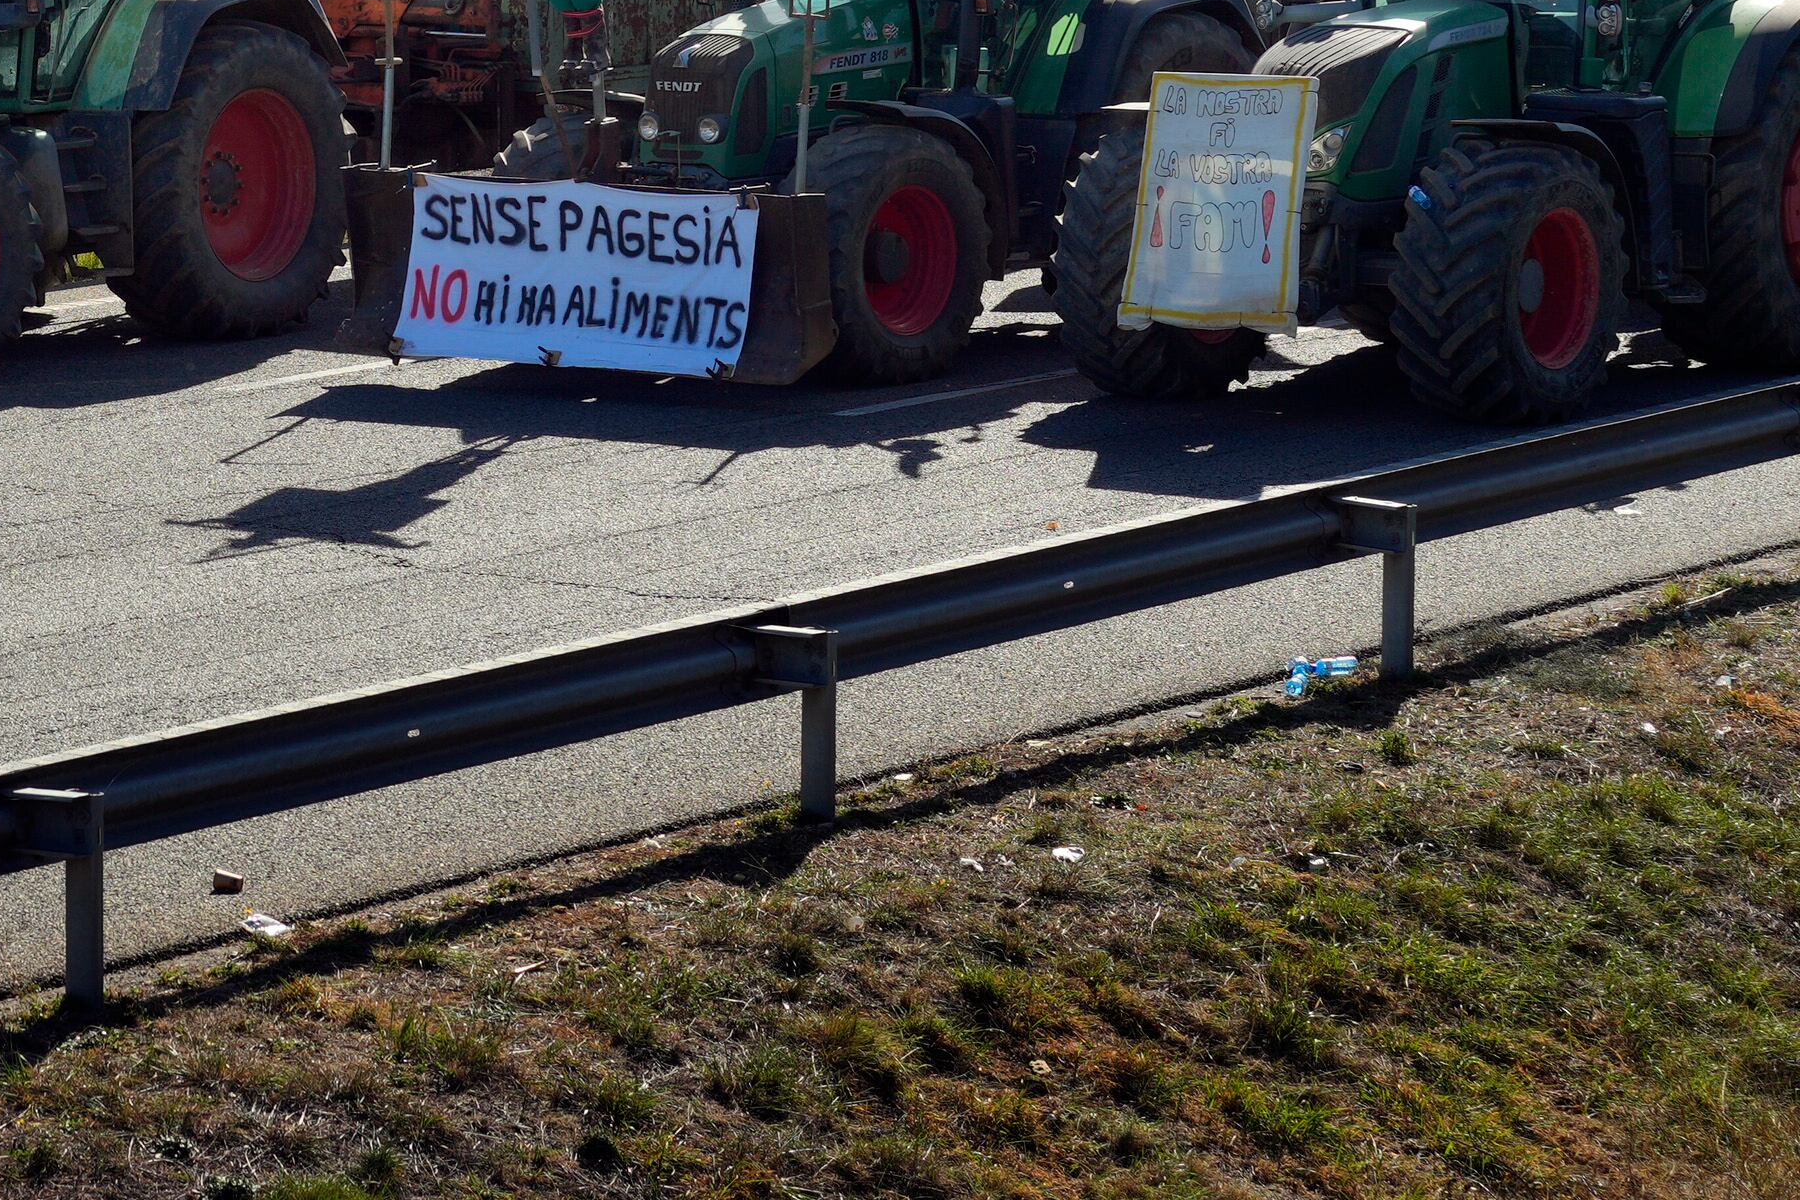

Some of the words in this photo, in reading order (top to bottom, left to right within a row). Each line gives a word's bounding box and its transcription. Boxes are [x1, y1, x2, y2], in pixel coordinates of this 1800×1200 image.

[829, 53, 867, 69] FENDT
[870, 50, 889, 63] 818
[656, 81, 702, 92] FENDT
[1163, 85, 1187, 116] LA
[1196, 88, 1283, 117] NOSTRA
[1155, 149, 1180, 179] LA
[1190, 151, 1272, 185] VOSTRA
[421, 192, 549, 252] SENSE
[410, 264, 469, 324] NO
[516, 284, 556, 326] HA
